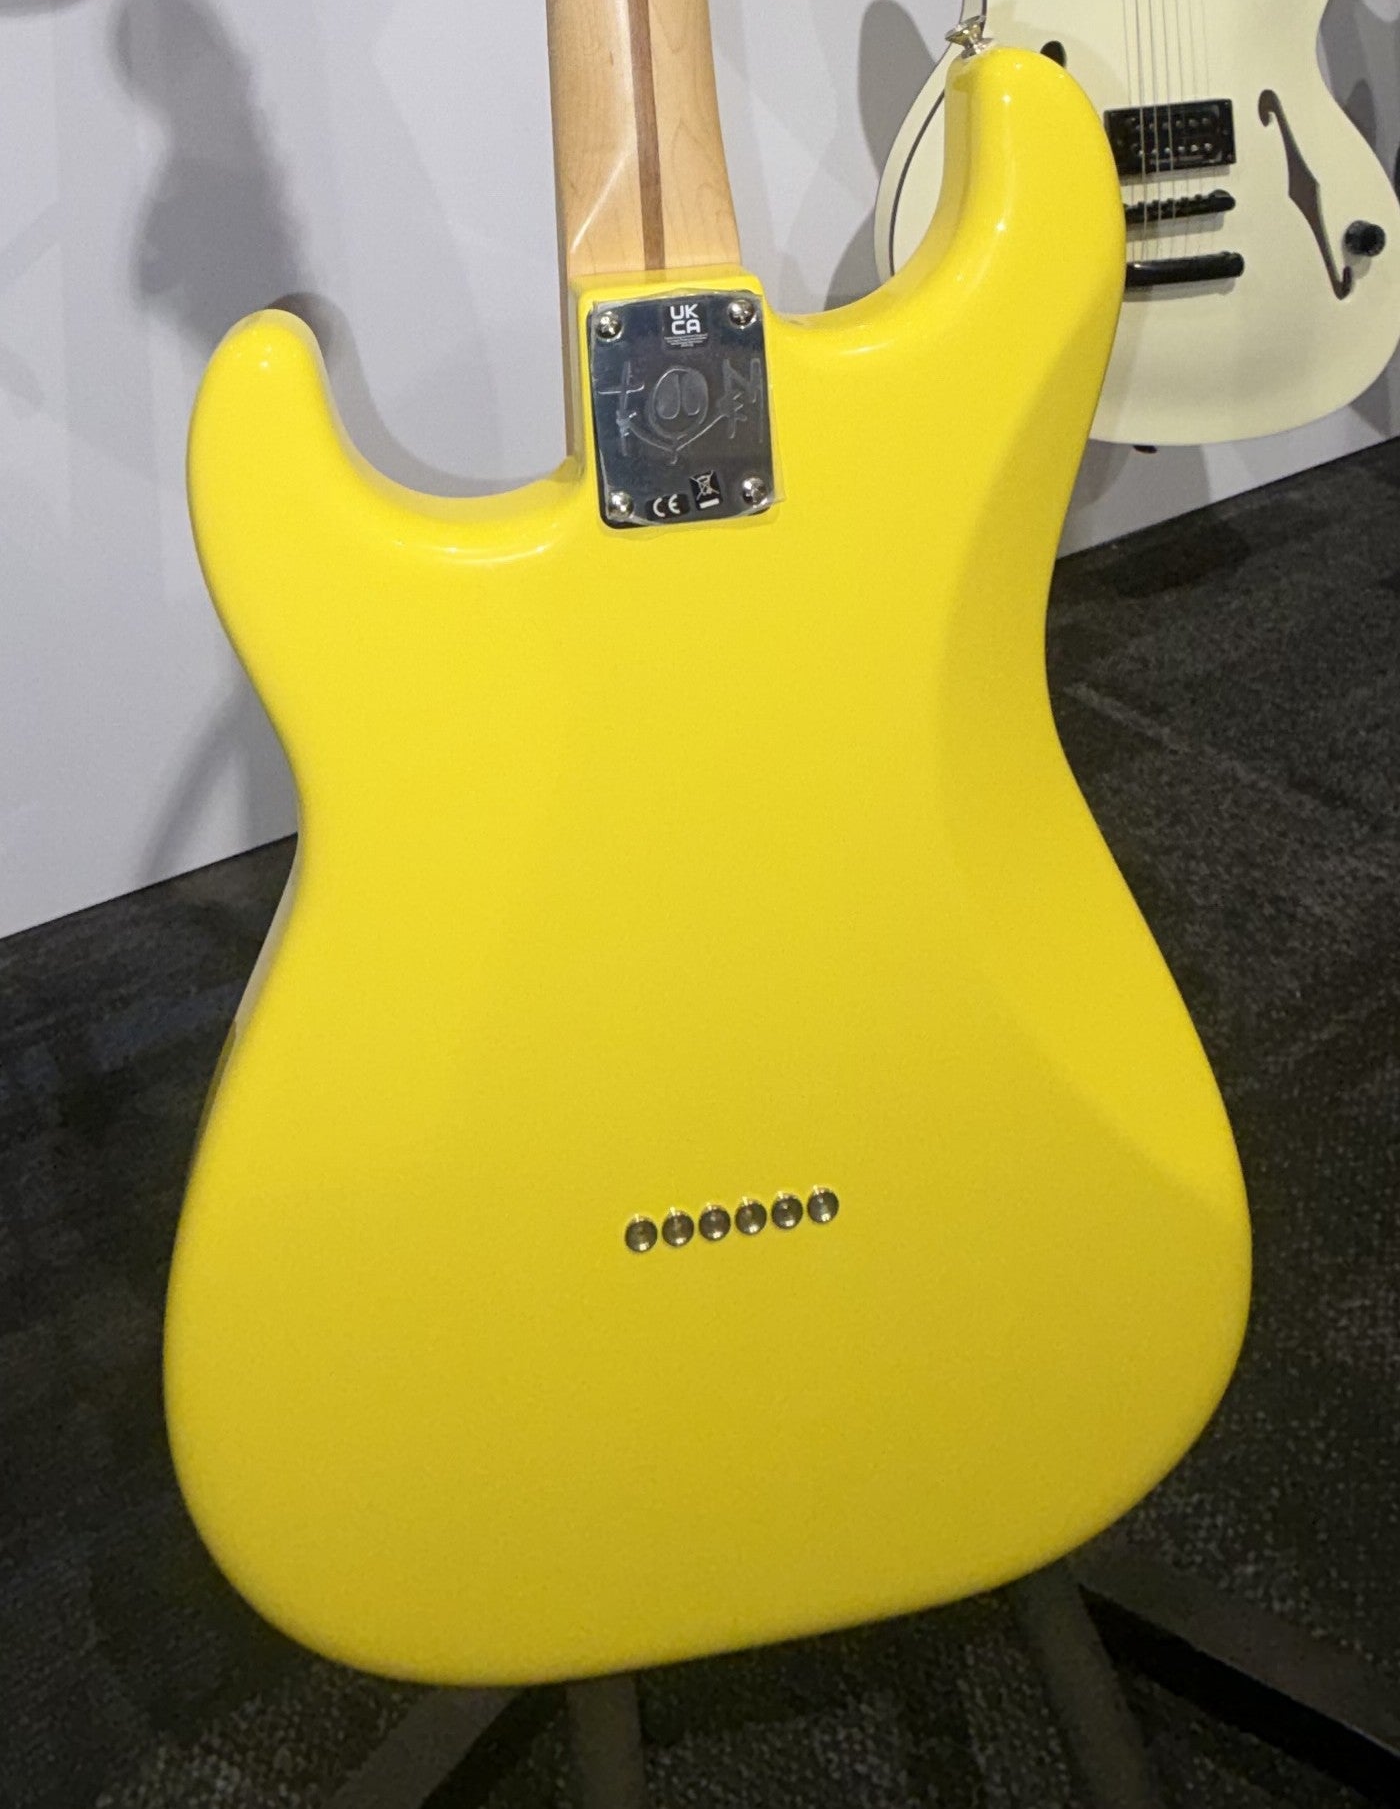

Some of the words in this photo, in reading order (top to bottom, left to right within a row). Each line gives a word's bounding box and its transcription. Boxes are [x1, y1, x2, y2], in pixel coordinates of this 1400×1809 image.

[669, 303, 698, 320] UK
[671, 318, 701, 335] CA
[652, 494, 681, 518] CE
